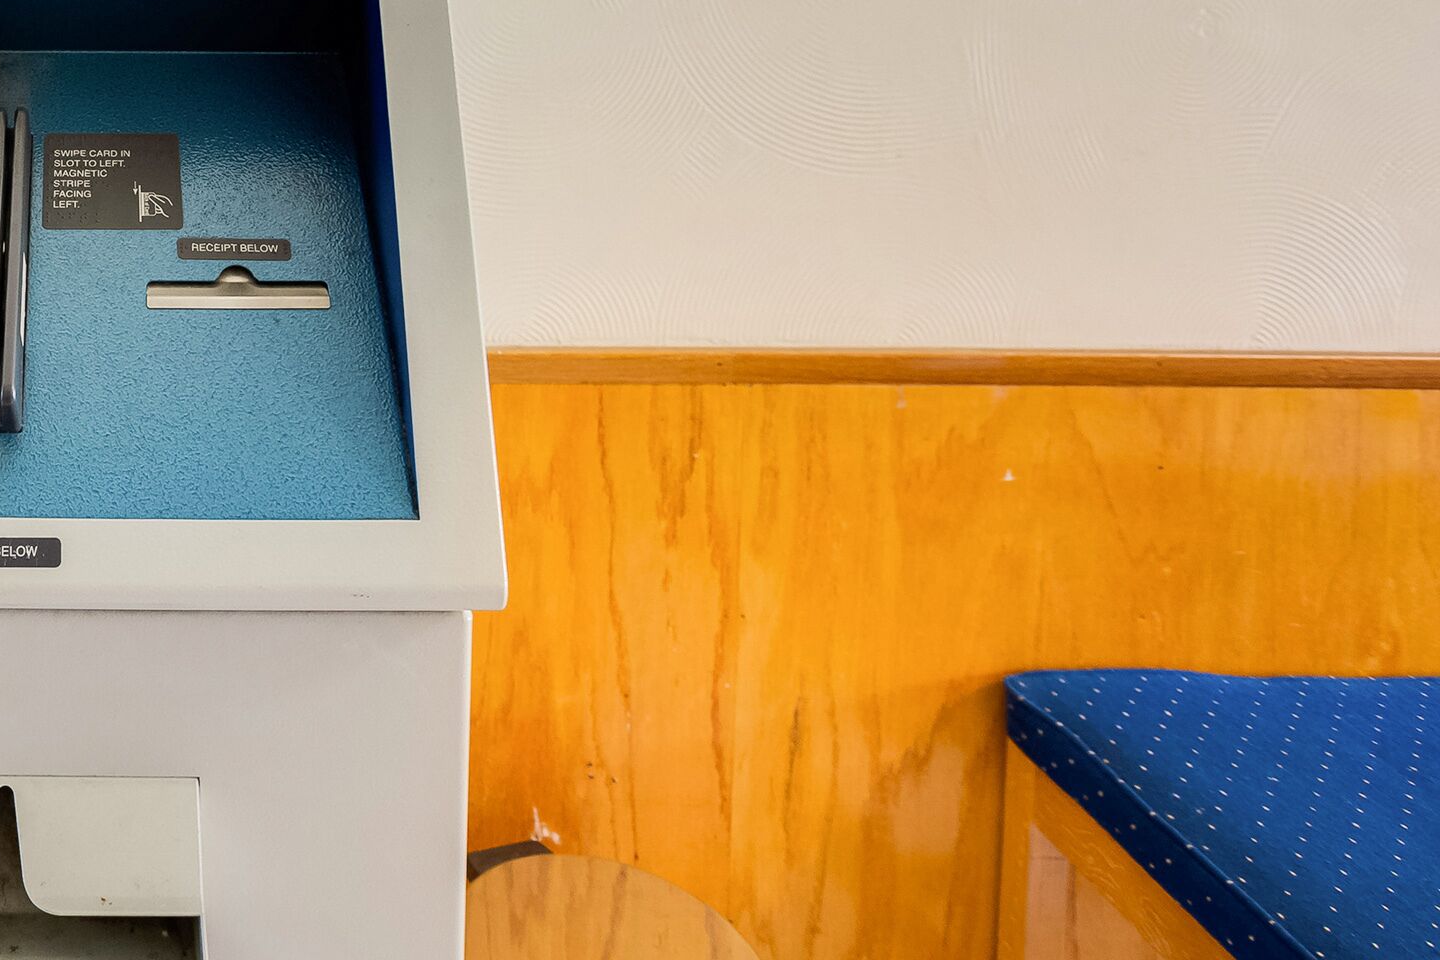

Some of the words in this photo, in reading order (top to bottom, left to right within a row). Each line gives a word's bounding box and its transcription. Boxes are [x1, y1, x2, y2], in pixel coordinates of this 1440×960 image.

[53, 149, 86, 157] SWIPE
[89, 149, 118, 157] CARD
[53, 159, 80, 167] SLOT
[82, 159, 97, 167] TO
[99, 159, 126, 168] LEFT.
[53, 169, 108, 177] MAGNETIC
[53, 179, 91, 188] STRIPE
[53, 190, 92, 198] FACING
[53, 200, 80, 208] LEFT.
[191, 243, 237, 252] RECEIPT
[240, 244, 278, 252] BELOW
